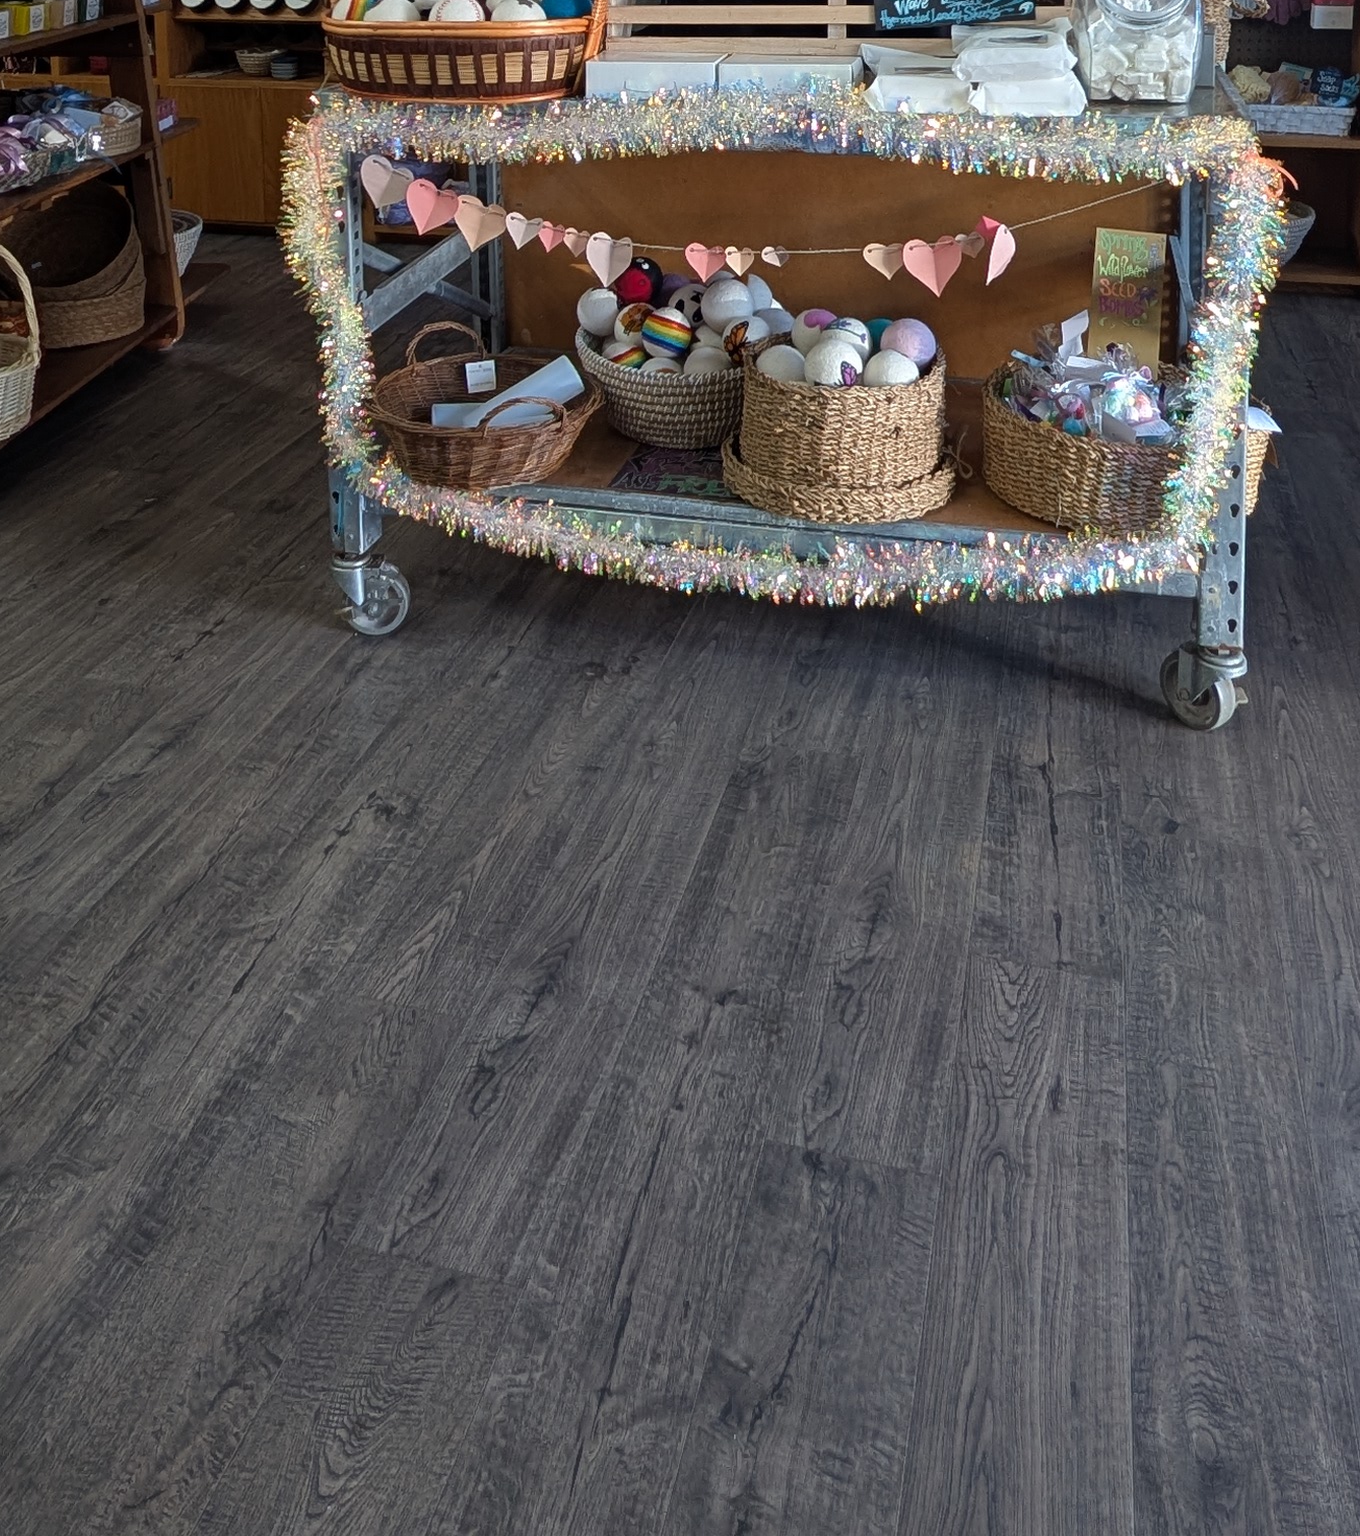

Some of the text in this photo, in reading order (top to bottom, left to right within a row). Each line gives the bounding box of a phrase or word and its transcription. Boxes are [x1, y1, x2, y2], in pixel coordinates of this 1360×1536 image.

[1317, 70, 1337, 84] Soap
[1100, 231, 1148, 262] Spring
[1097, 253, 1148, 282] Wildflower
[1100, 278, 1136, 297] SEED
